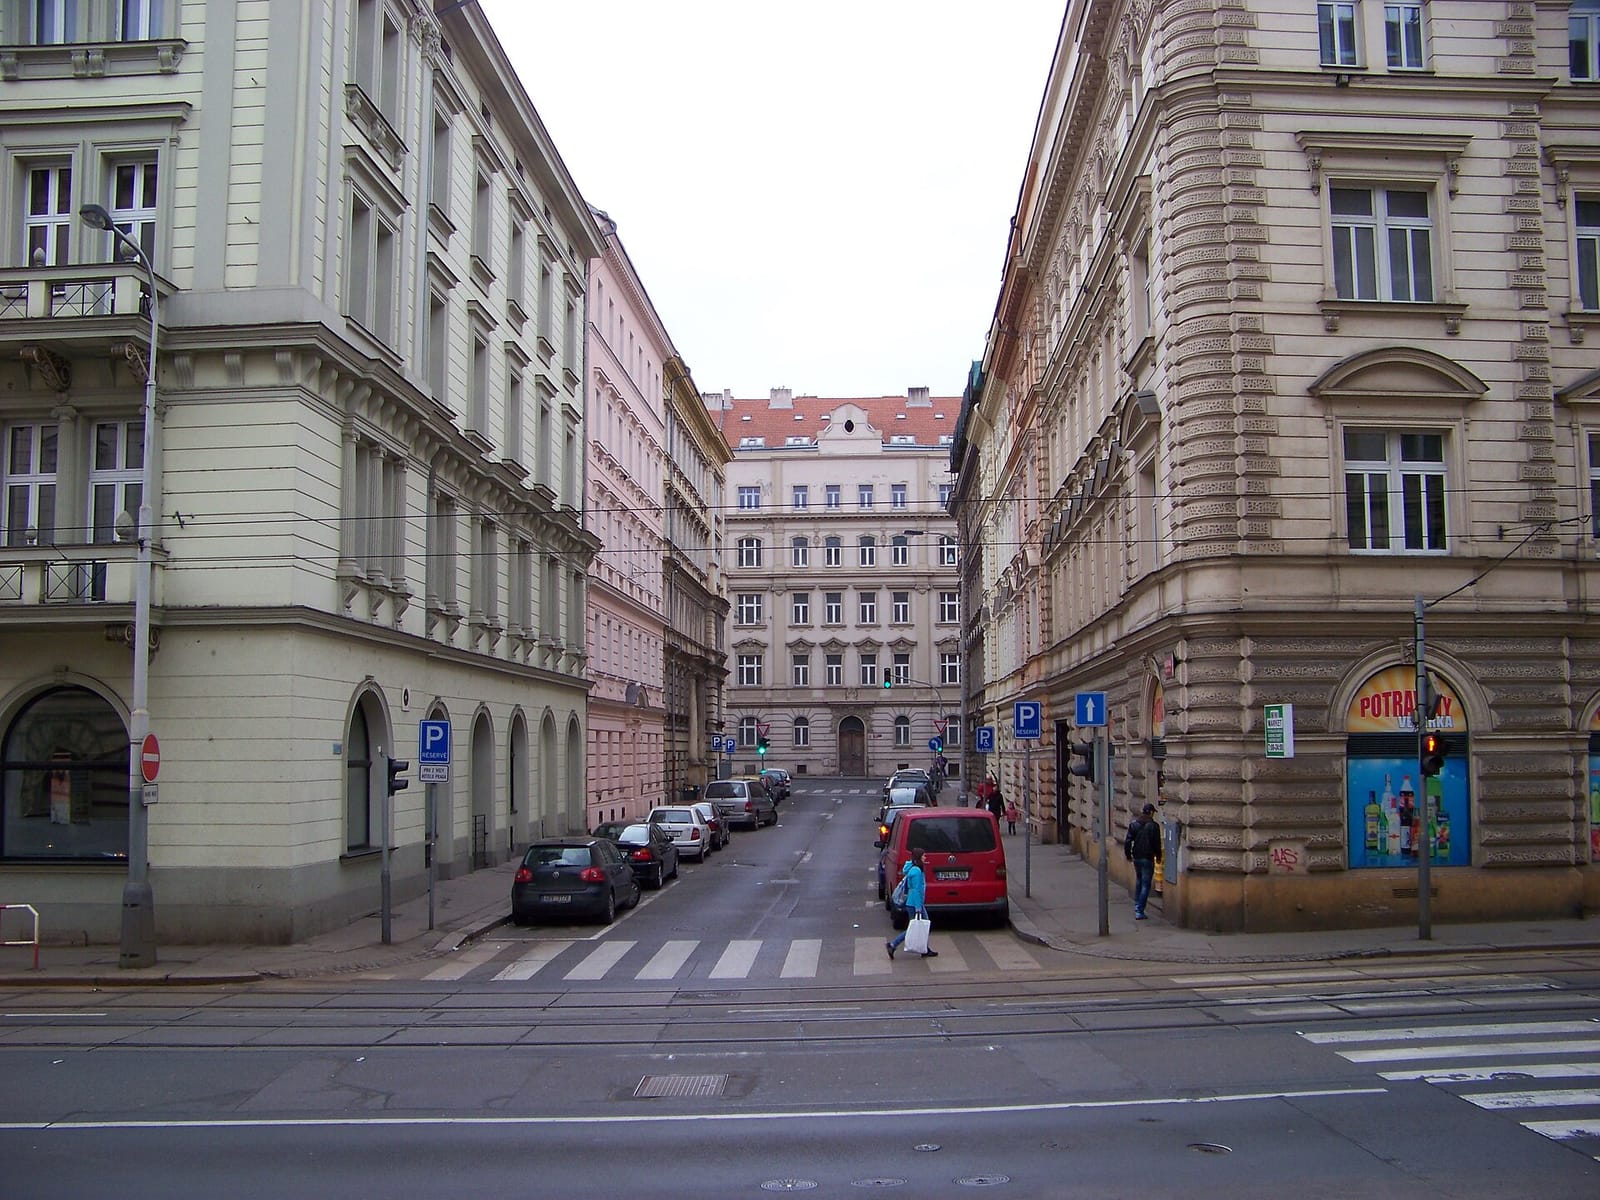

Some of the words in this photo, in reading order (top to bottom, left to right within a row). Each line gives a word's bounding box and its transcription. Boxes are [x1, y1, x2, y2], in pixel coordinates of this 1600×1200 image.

[1360, 690, 1452, 718] POTRAY
[1020, 706, 1034, 727] P
[426, 725, 444, 750] P
[713, 737, 720, 747] P
[727, 740, 734, 749] P
[980, 730, 990, 744] P
